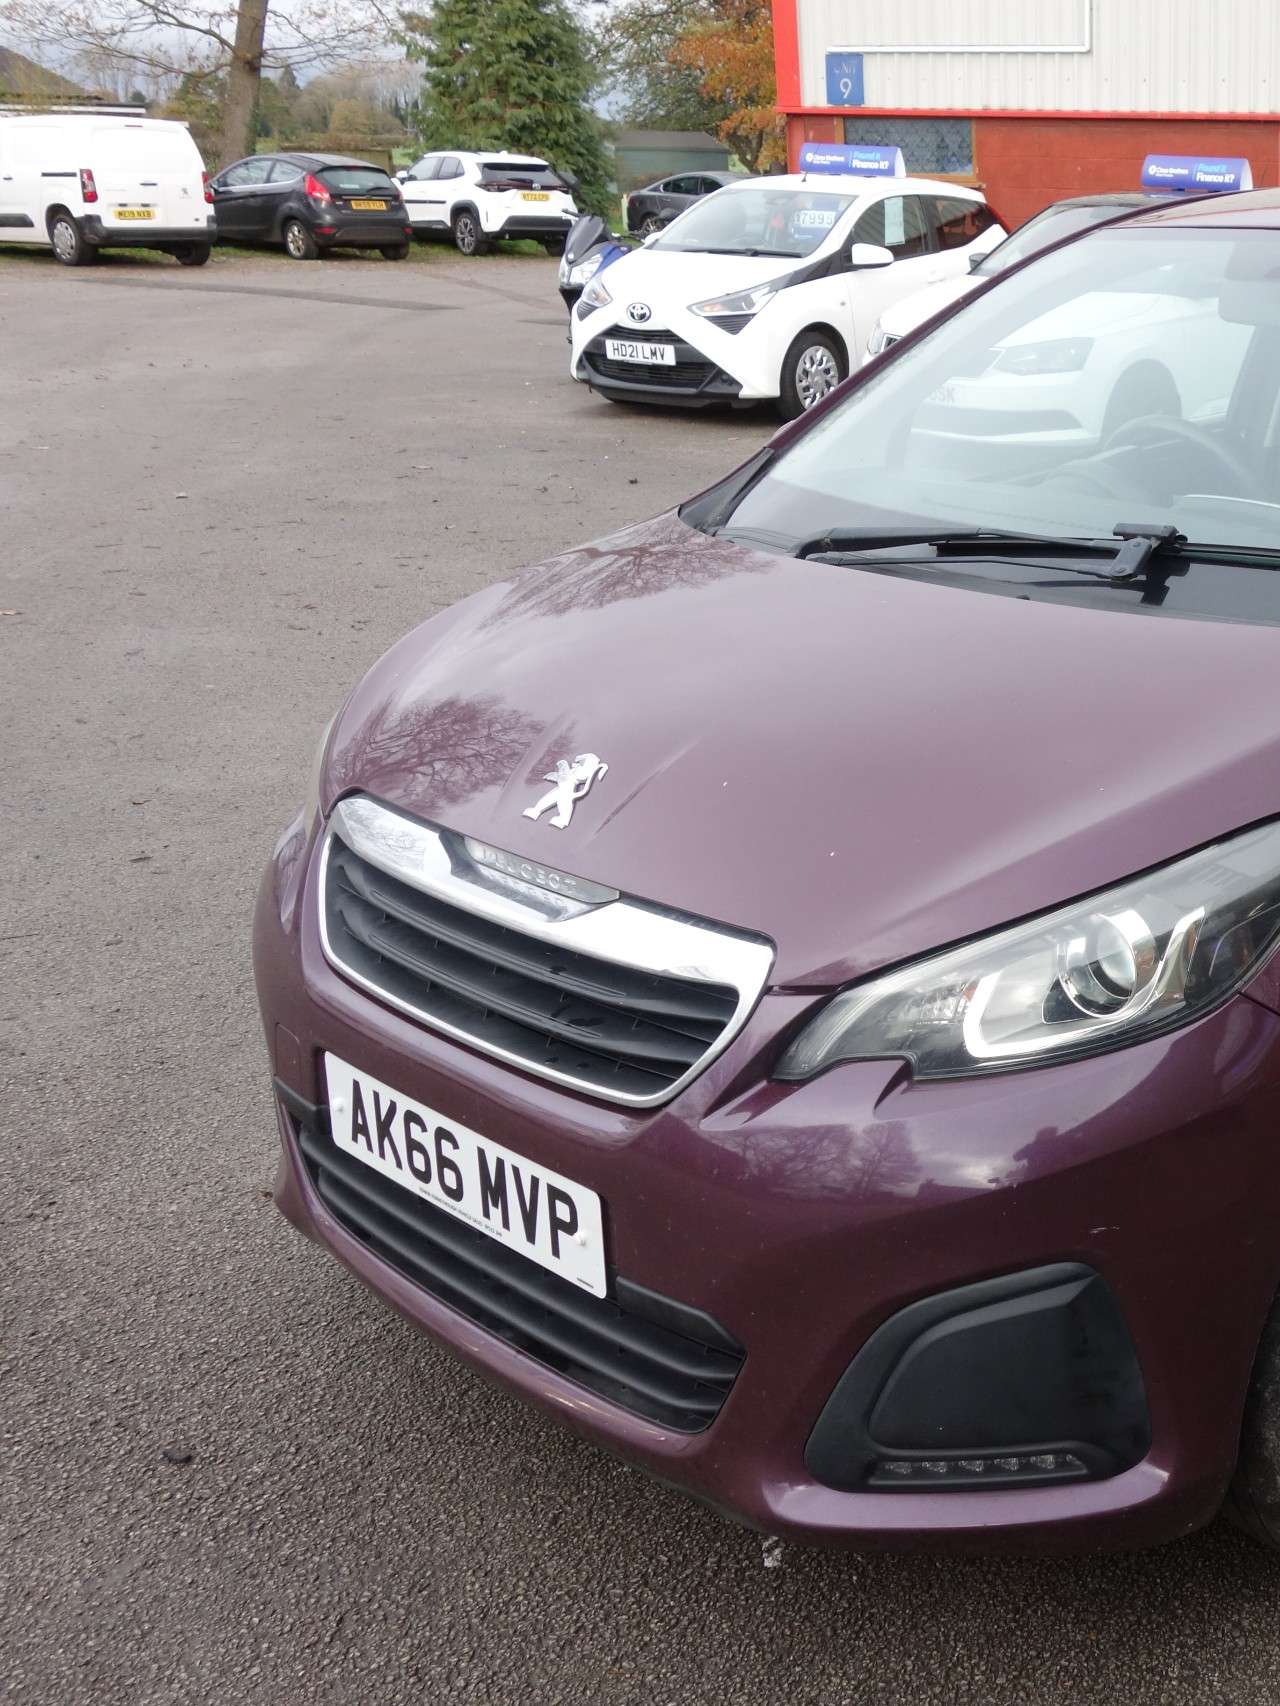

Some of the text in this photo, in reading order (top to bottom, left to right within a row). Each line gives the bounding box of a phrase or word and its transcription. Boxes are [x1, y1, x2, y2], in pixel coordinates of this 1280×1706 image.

[839, 78, 852, 99] 9
[852, 159, 879, 169] Finance
[1196, 172, 1224, 182] Finance
[611, 342, 665, 361] HD21 LMV
[482, 846, 578, 894] PEUGEOT
[351, 1078, 464, 1203] AK66
[476, 1145, 579, 1260] MVP
